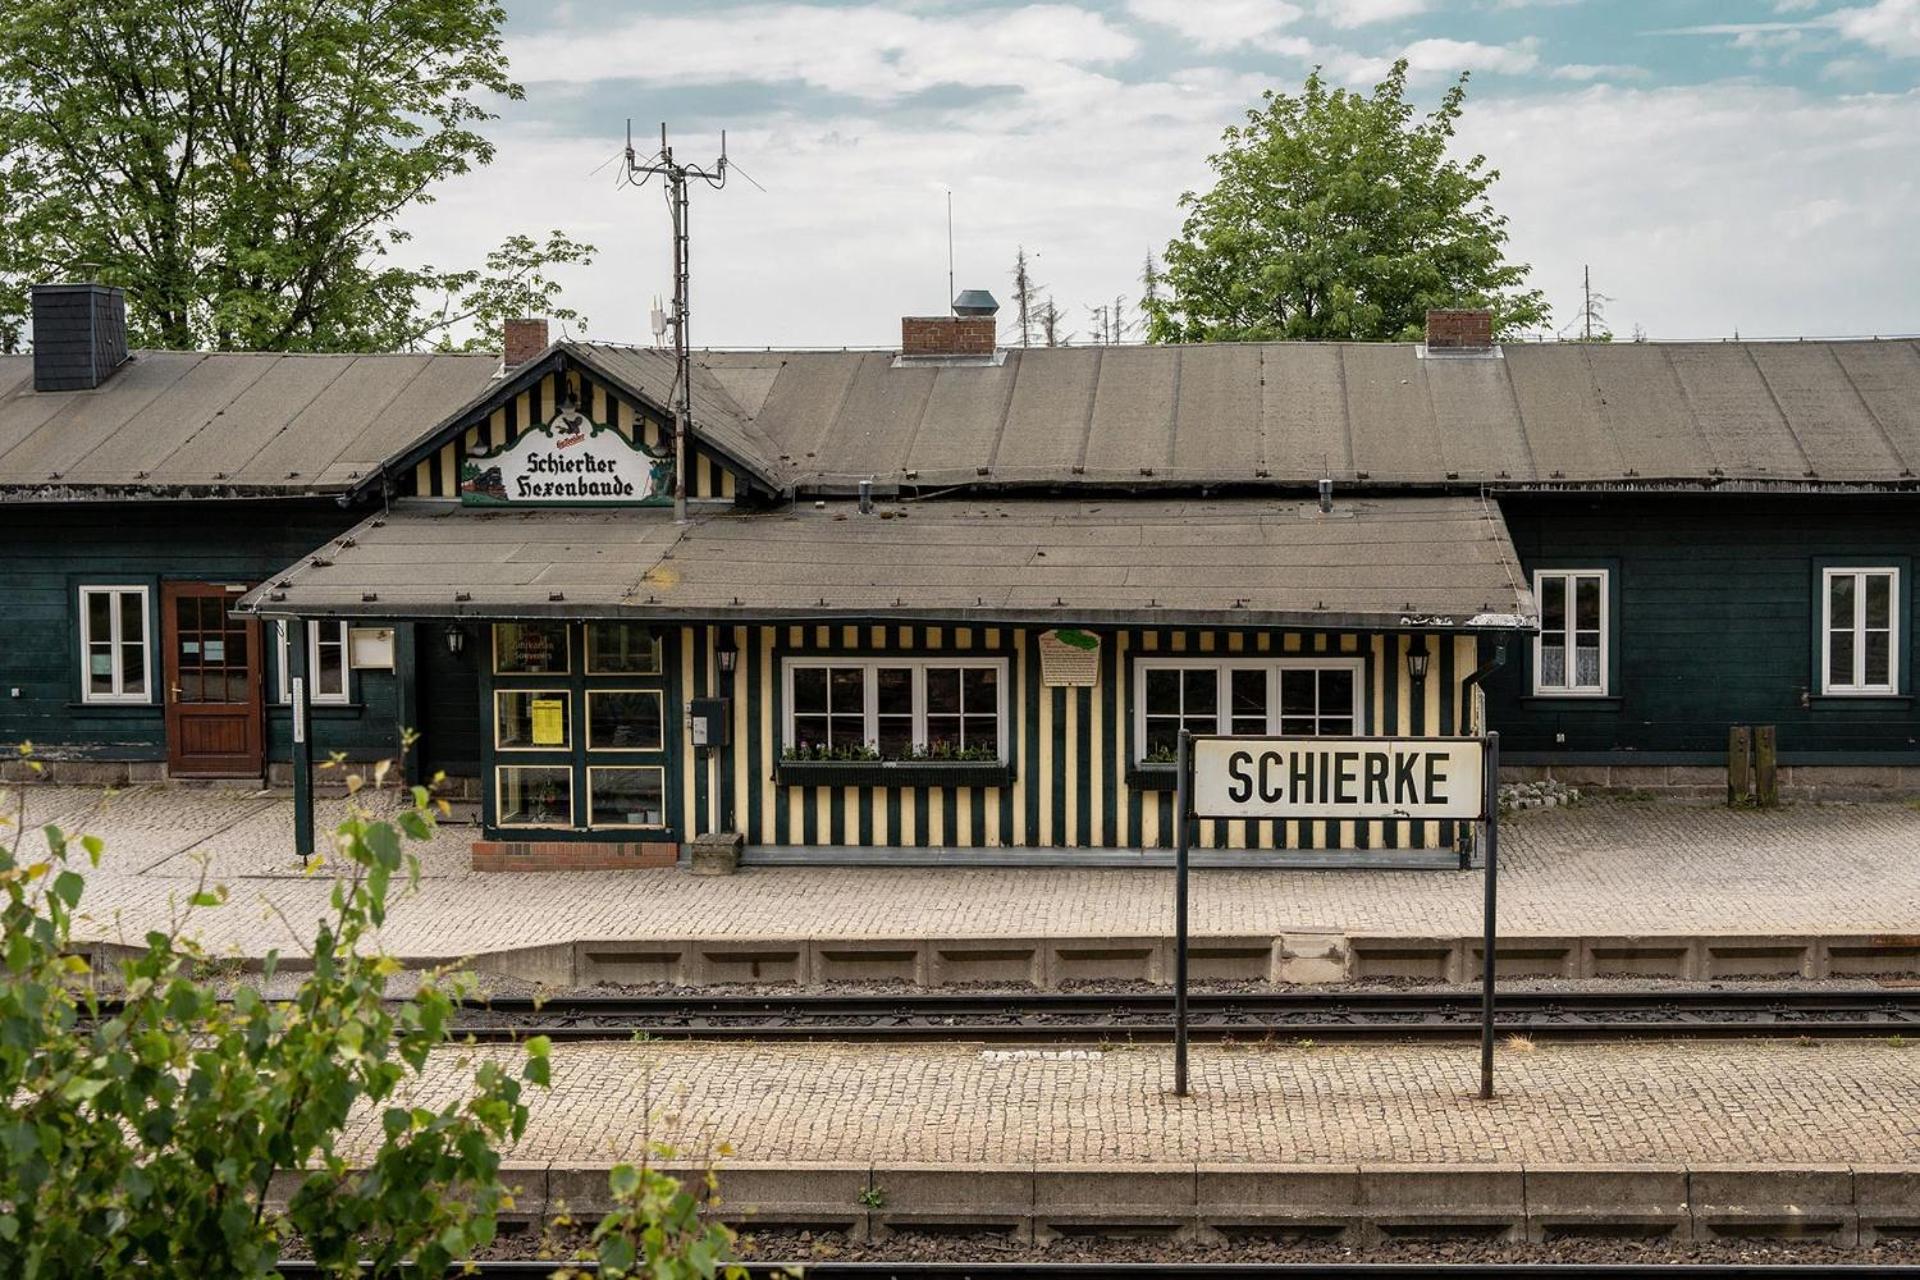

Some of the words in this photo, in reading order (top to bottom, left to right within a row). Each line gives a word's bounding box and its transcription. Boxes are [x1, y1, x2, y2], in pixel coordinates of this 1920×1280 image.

[526, 452, 617, 476] Schierker
[516, 475, 634, 497] Hexenbaude
[1228, 750, 1450, 804] SCHIERKE
